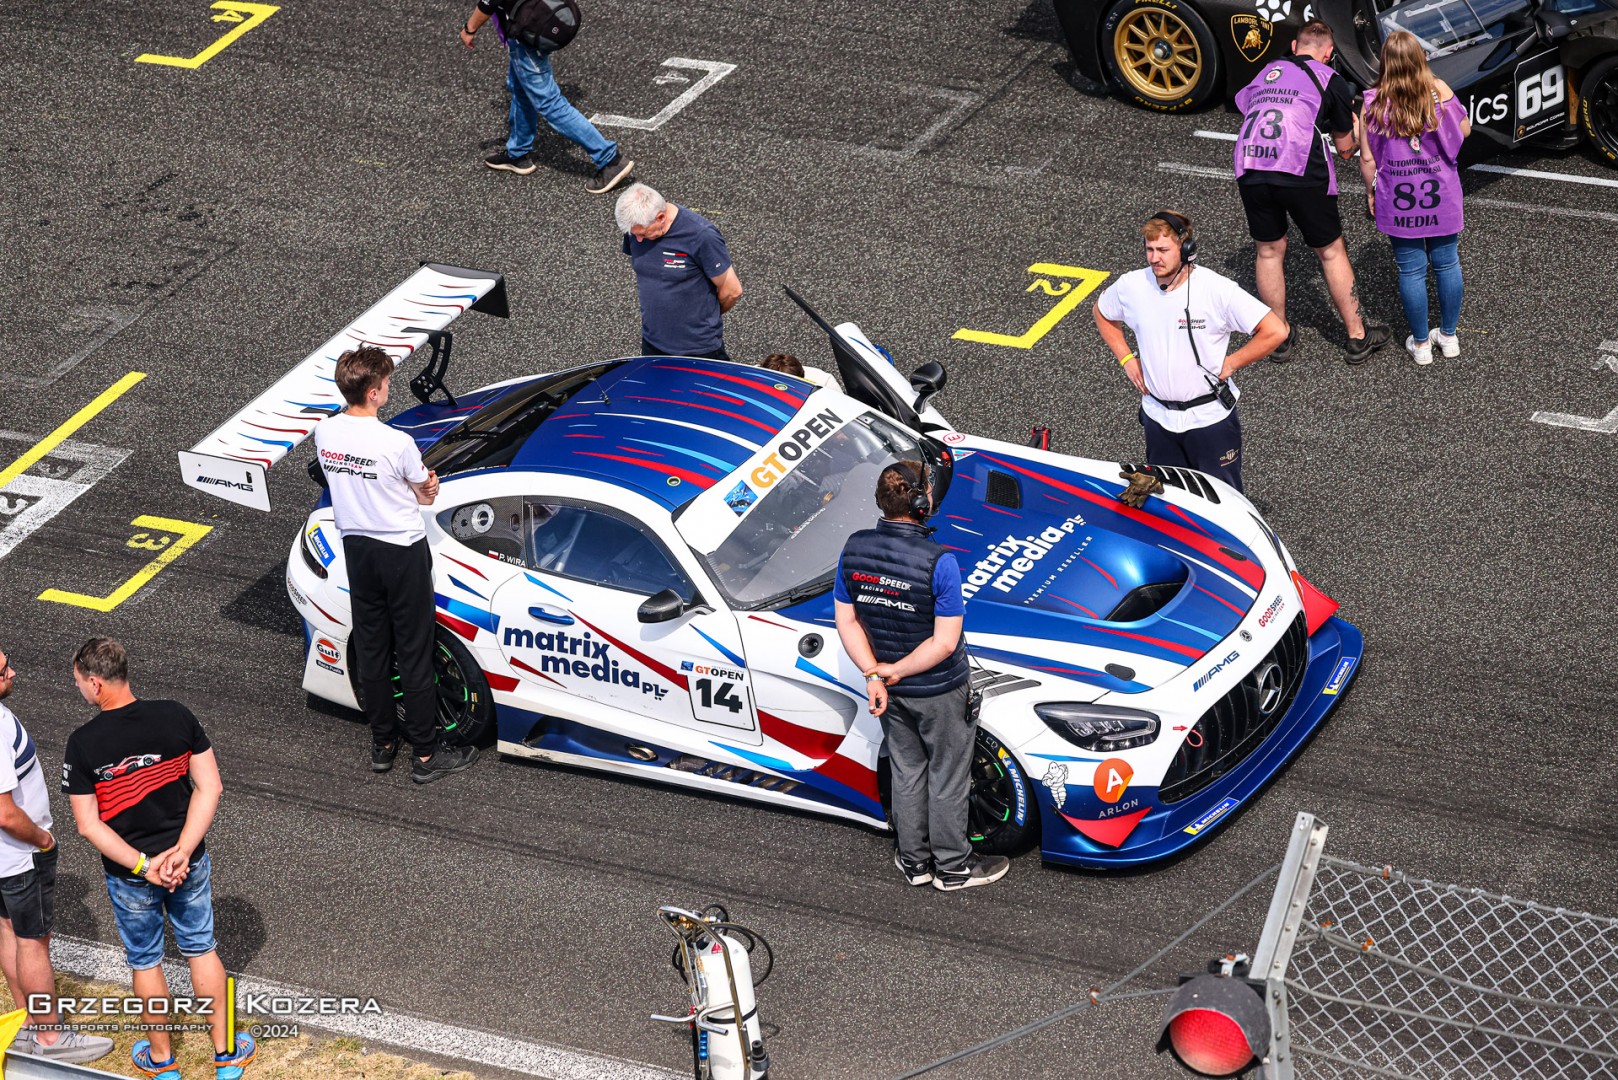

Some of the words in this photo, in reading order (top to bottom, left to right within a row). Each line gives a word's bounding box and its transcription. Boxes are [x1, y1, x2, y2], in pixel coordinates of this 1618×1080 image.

[1518, 65, 1564, 120] 69
[1393, 179, 1442, 211] 83
[1394, 214, 1439, 228] MEDIA
[852, 572, 912, 590] GOODSPEED
[1023, 574, 1057, 604] PREMIUM
[1056, 535, 1093, 573] RESELLER
[1258, 595, 1283, 628] GOODSPEED
[316, 643, 340, 659] Gulf
[503, 627, 610, 660] matrix
[696, 678, 743, 714] 14
[1009, 767, 1025, 822] MICHELIN
[1098, 798, 1139, 819] ARLON
